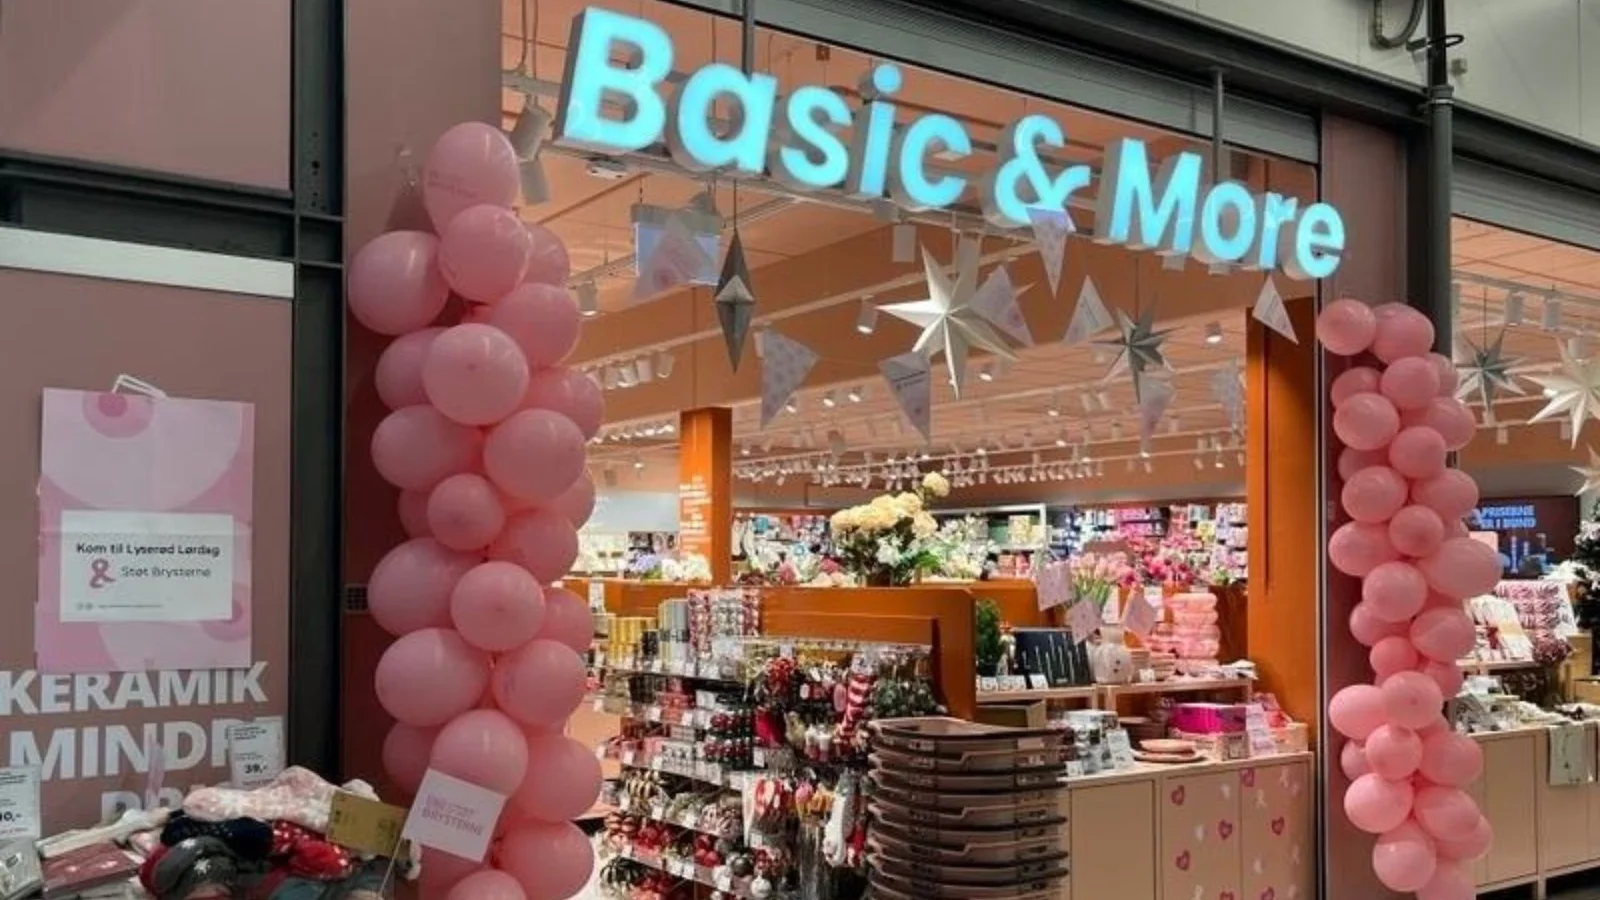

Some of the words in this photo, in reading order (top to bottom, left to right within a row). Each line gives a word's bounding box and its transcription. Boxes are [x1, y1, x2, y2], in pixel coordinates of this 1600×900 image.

[566, 10, 971, 207] Basic
[994, 115, 1090, 224] &
[1108, 137, 1346, 278] More
[76, 542, 107, 554] Kom
[110, 543, 123, 554] til
[126, 543, 175, 556] Lyserød
[178, 544, 221, 558] Lørdag
[0, 661, 269, 715] KERAMIK
